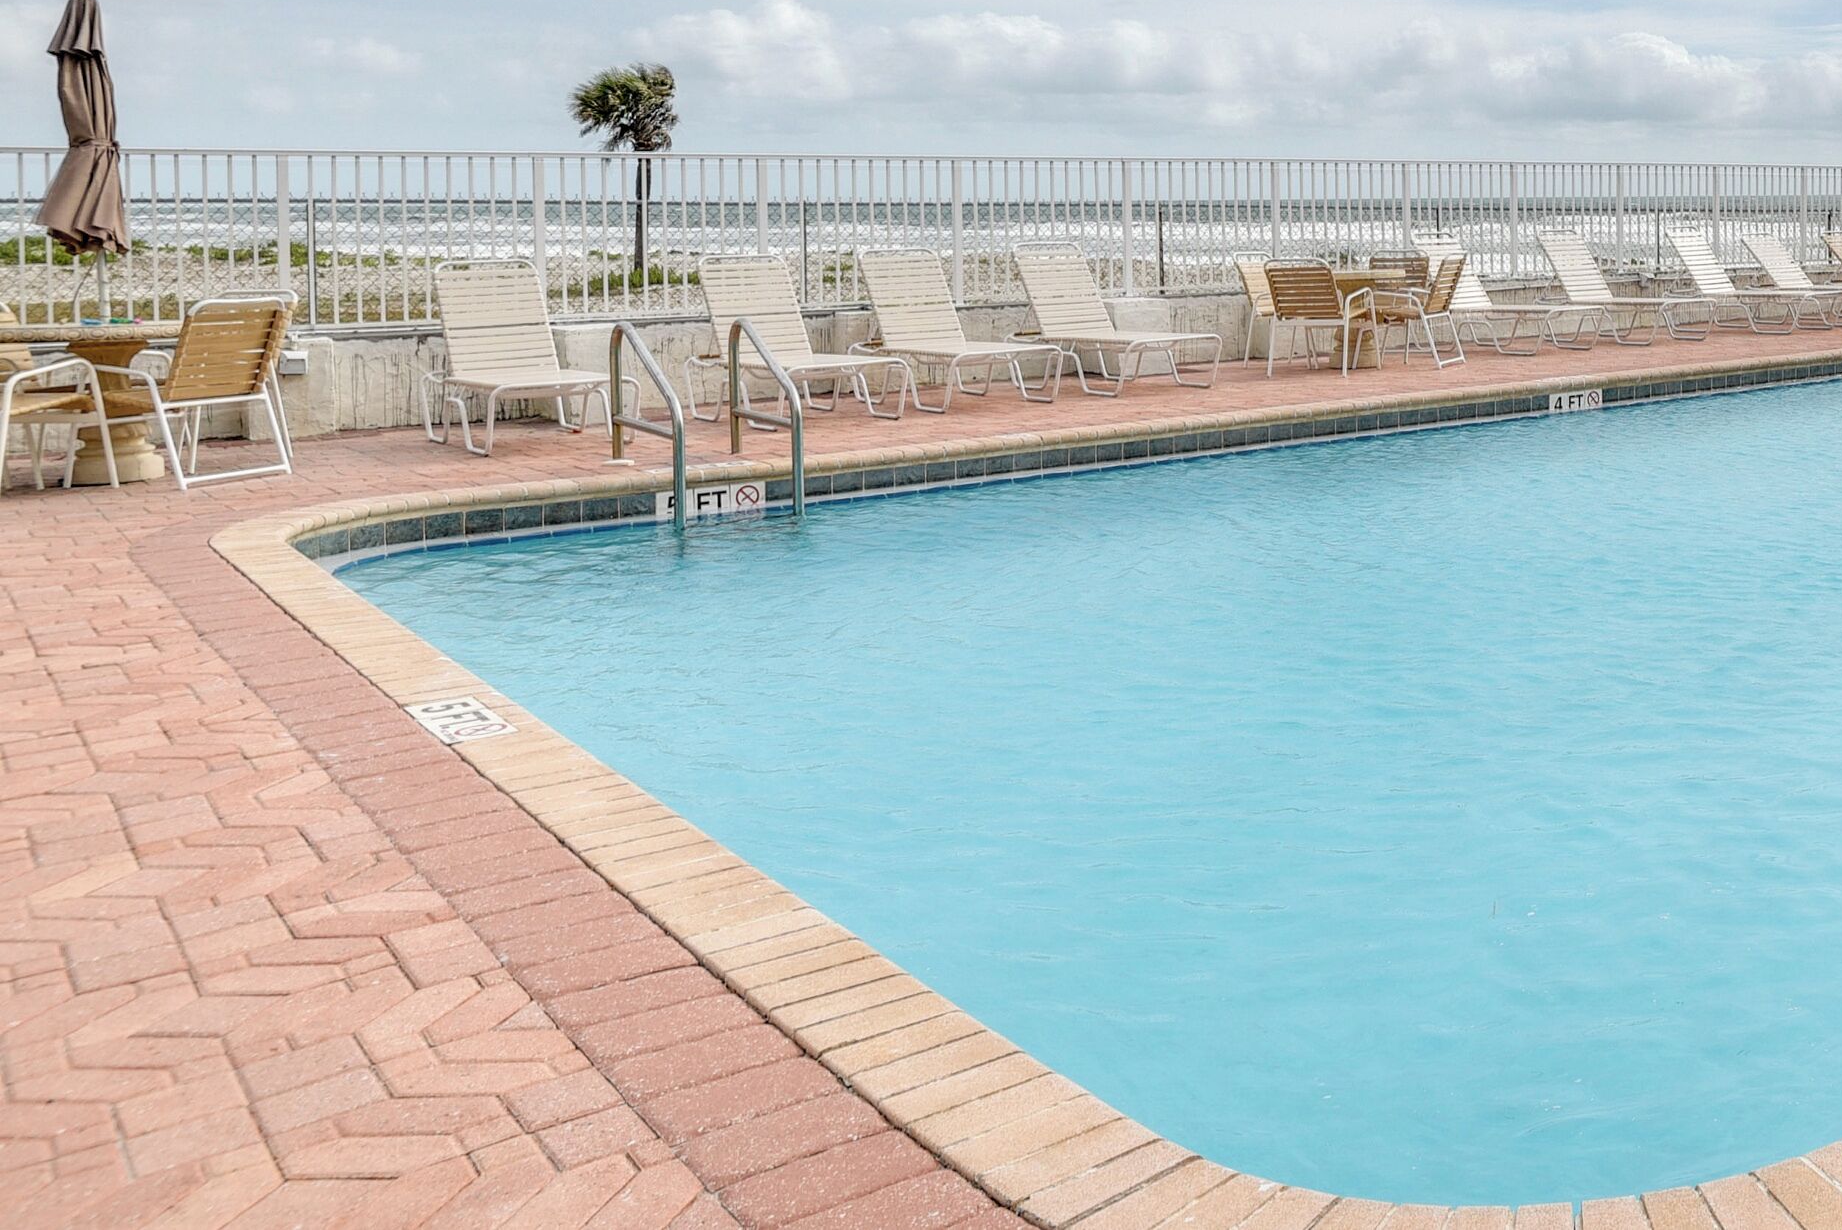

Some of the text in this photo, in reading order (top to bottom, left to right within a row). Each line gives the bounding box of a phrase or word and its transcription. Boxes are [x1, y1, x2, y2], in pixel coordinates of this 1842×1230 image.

[1554, 394, 1584, 409] 4 FT
[697, 490, 728, 510] FT
